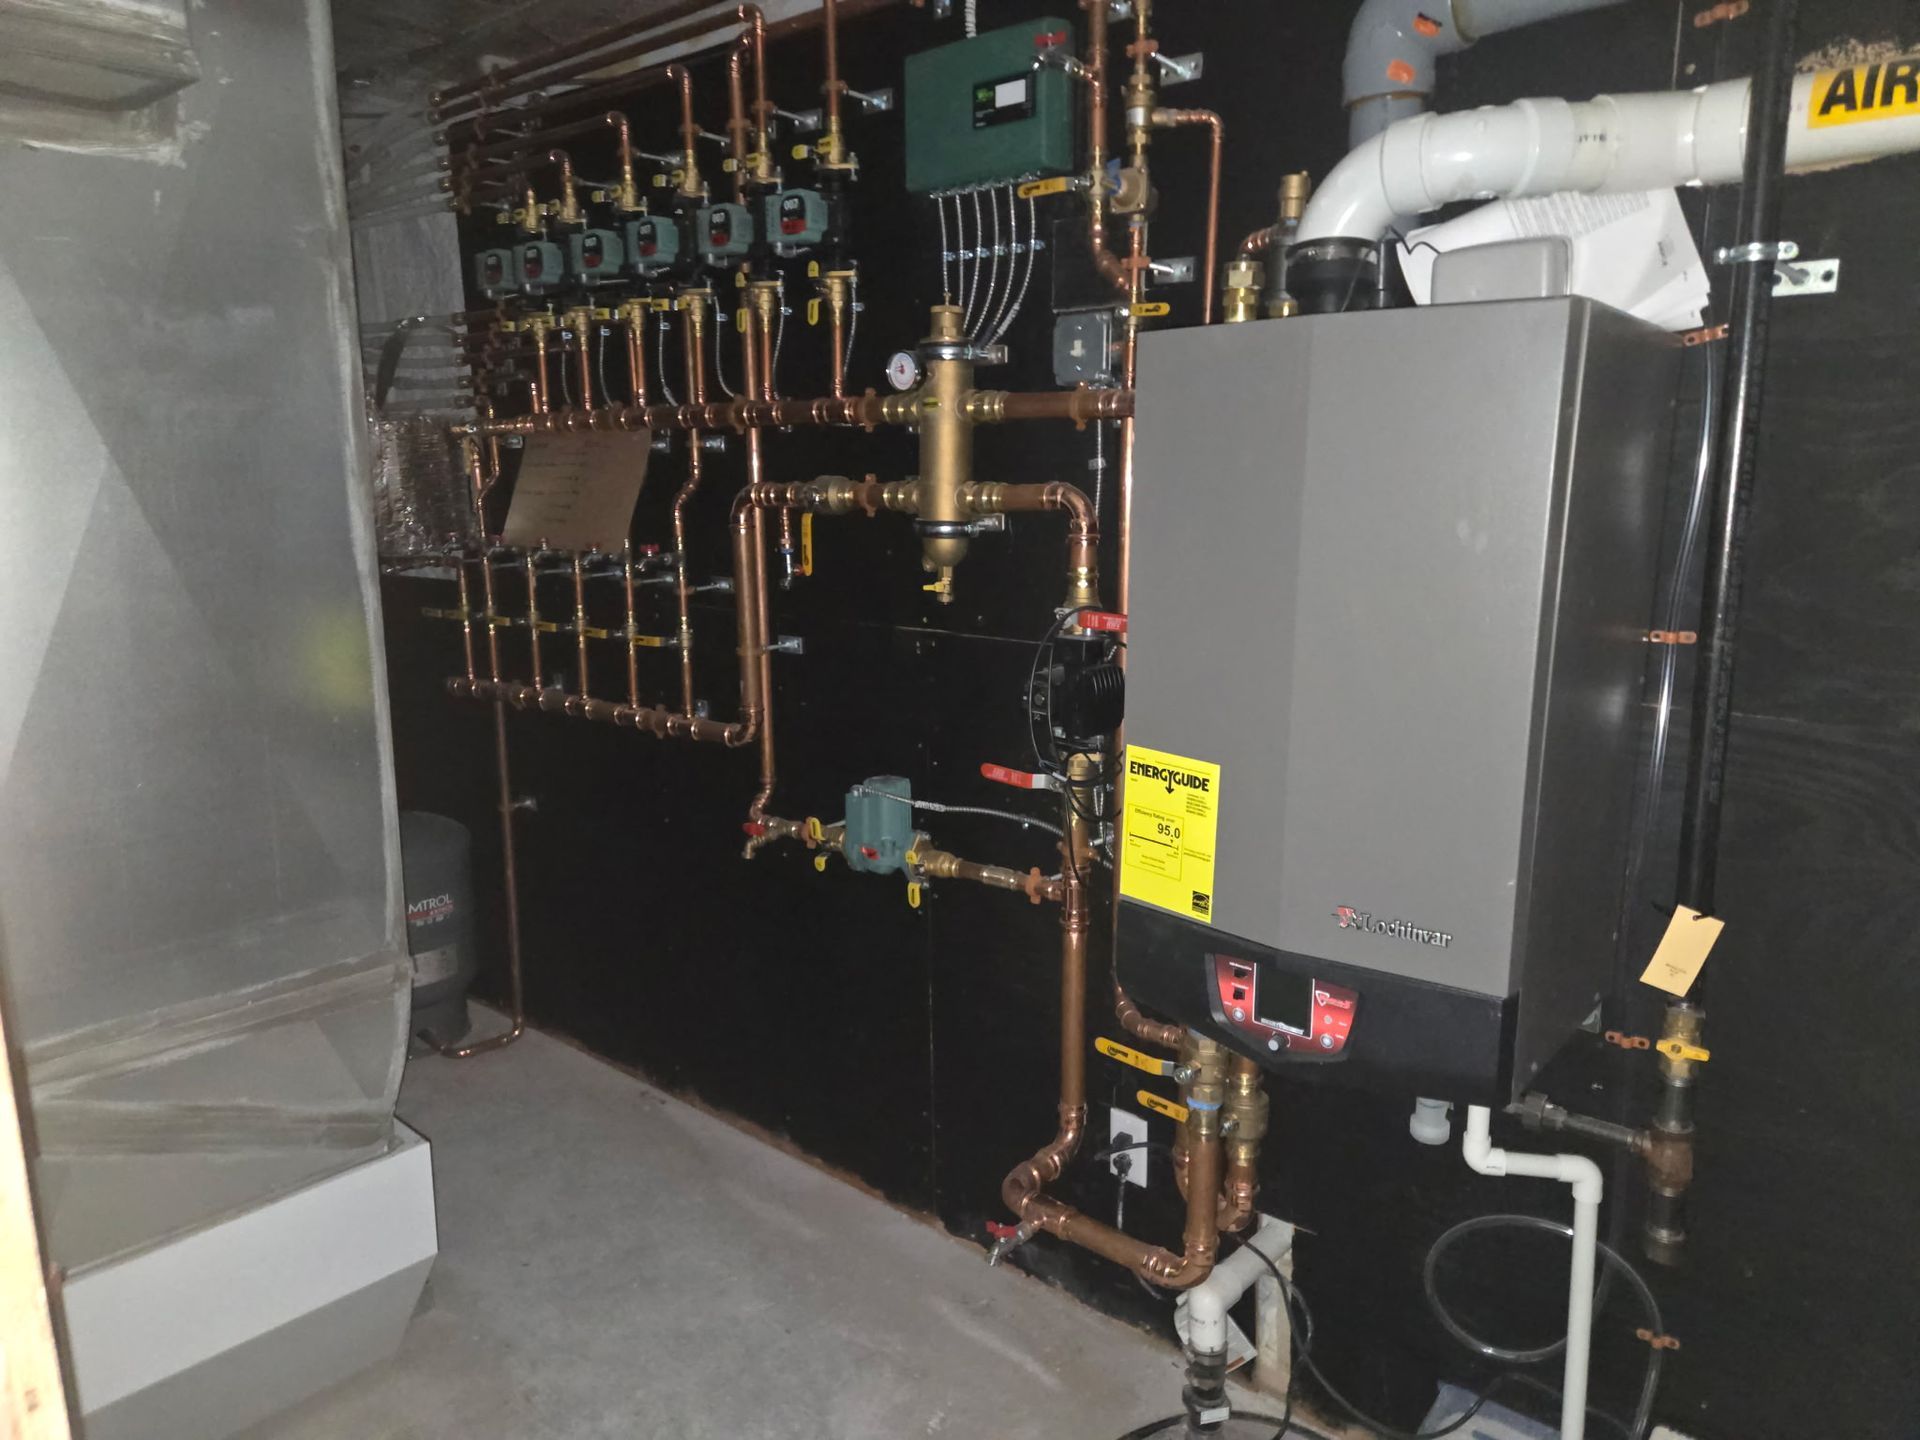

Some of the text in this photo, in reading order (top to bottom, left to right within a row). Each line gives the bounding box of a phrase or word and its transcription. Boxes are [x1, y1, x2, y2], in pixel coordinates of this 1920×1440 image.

[1818, 58, 1920, 116] AIR
[1130, 760, 1210, 793] ENERGYGUIDE
[1157, 823, 1181, 839] 95.0
[408, 893, 452, 914] MTROL
[1360, 913, 1452, 948] Lochinvar
